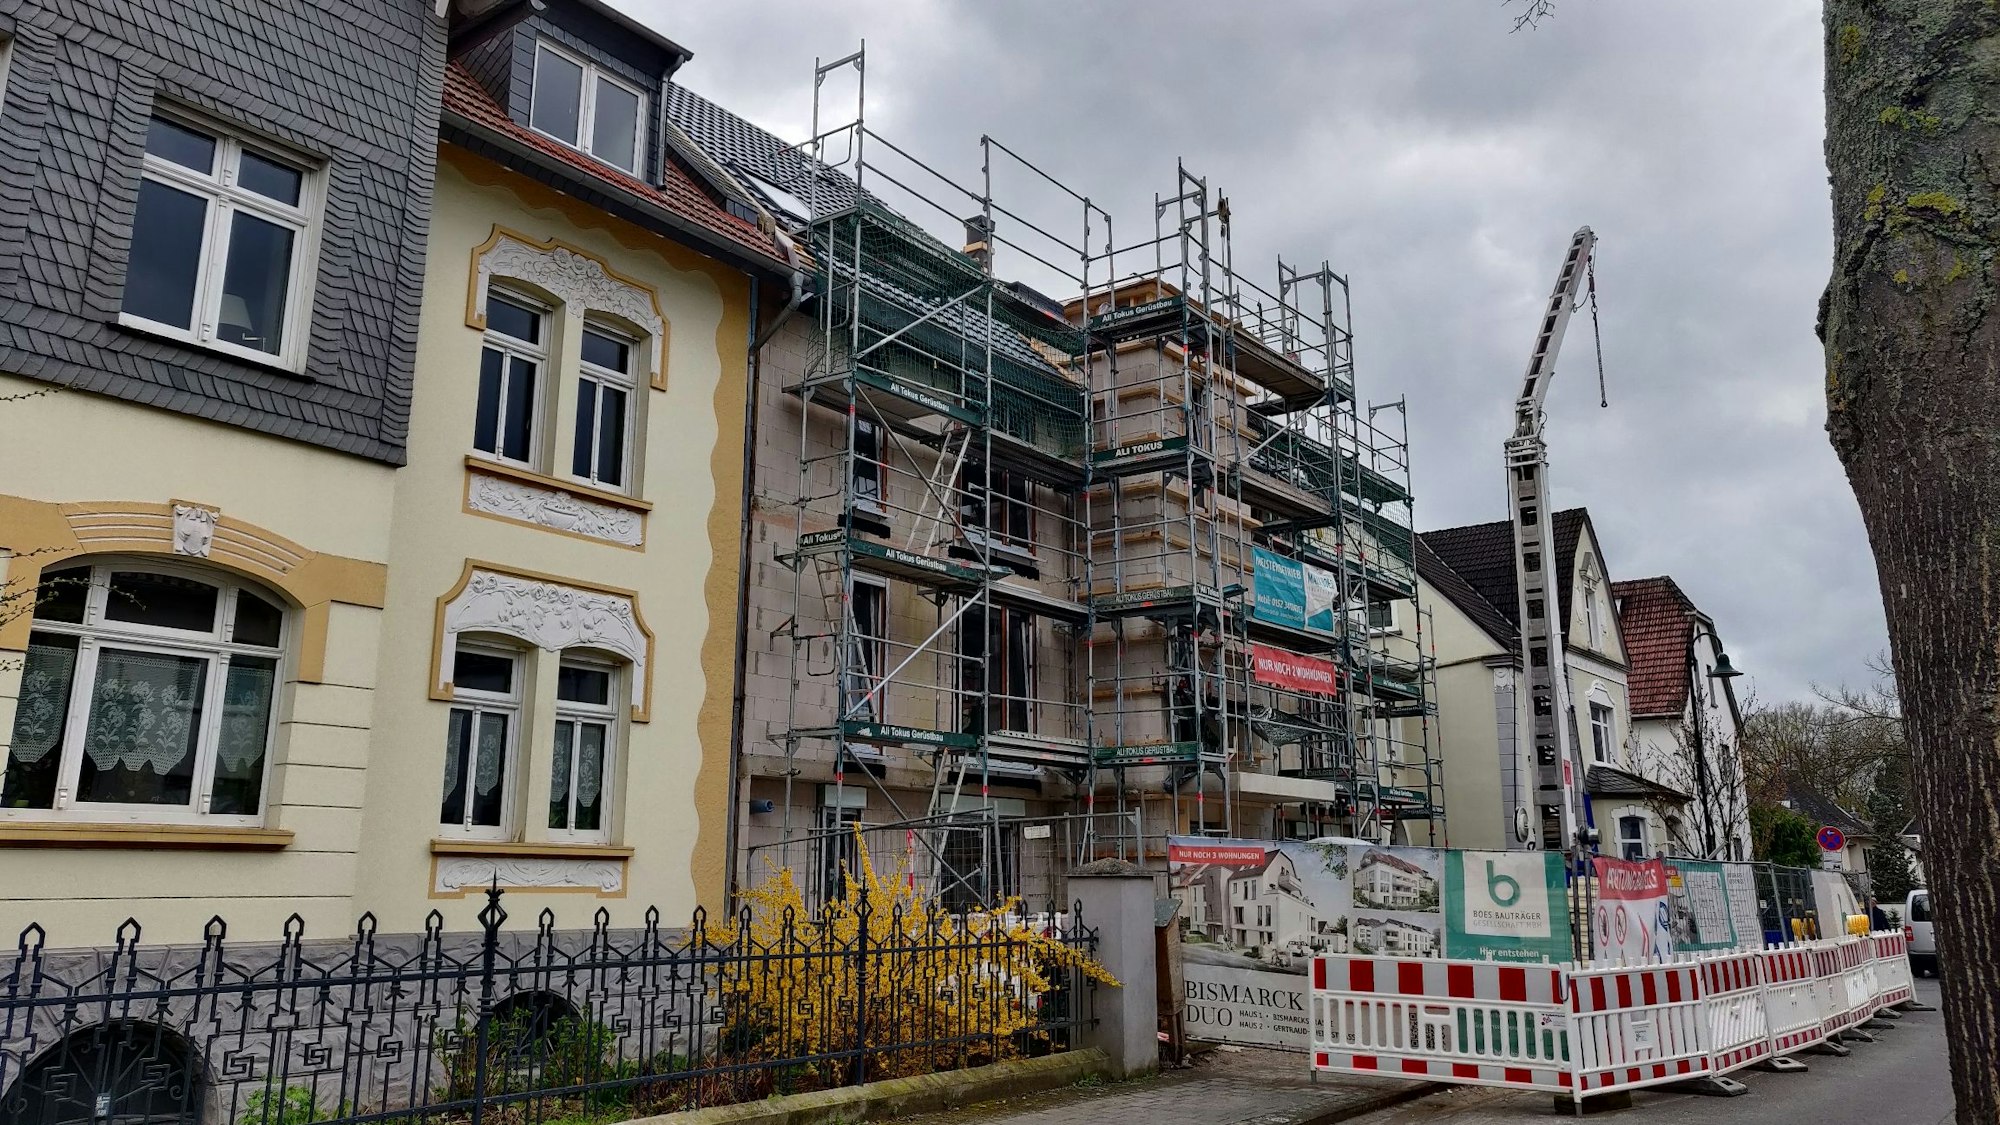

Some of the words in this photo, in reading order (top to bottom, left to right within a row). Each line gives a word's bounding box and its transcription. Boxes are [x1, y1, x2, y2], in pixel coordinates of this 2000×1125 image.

[1113, 308, 1135, 319] Tokus
[1135, 300, 1173, 314] Gerüstbau
[1115, 446, 1131, 457] ALI
[1132, 441, 1163, 454] TOKUS
[896, 552, 915, 564] Tokus
[915, 556, 947, 572] Gerüstbau
[1258, 657, 1274, 671] NUR
[1273, 660, 1291, 676] NOCH
[1295, 666, 1333, 684] WOHNUNGEN
[890, 727, 910, 738] Tokus
[911, 729, 944, 742] Gerüstbau
[1126, 747, 1144, 756] TOKUS
[1144, 744, 1178, 755] GERÜSTBAU
[1178, 850, 1192, 858] NUR
[1193, 851, 1211, 859] NOCH
[1218, 852, 1260, 860] WOHNUNGEN
[1472, 910, 1493, 919] BOES
[1495, 910, 1541, 920] BAUTRÄGER
[1472, 920, 1524, 929] GESELLSCHAFT
[1497, 949, 1540, 958] entstehen
[1185, 980, 1305, 1011] BISMARCK
[1185, 1004, 1233, 1027] DUO
[1239, 1010, 1258, 1018] HAUS
[1239, 1021, 1258, 1029] HAUS
